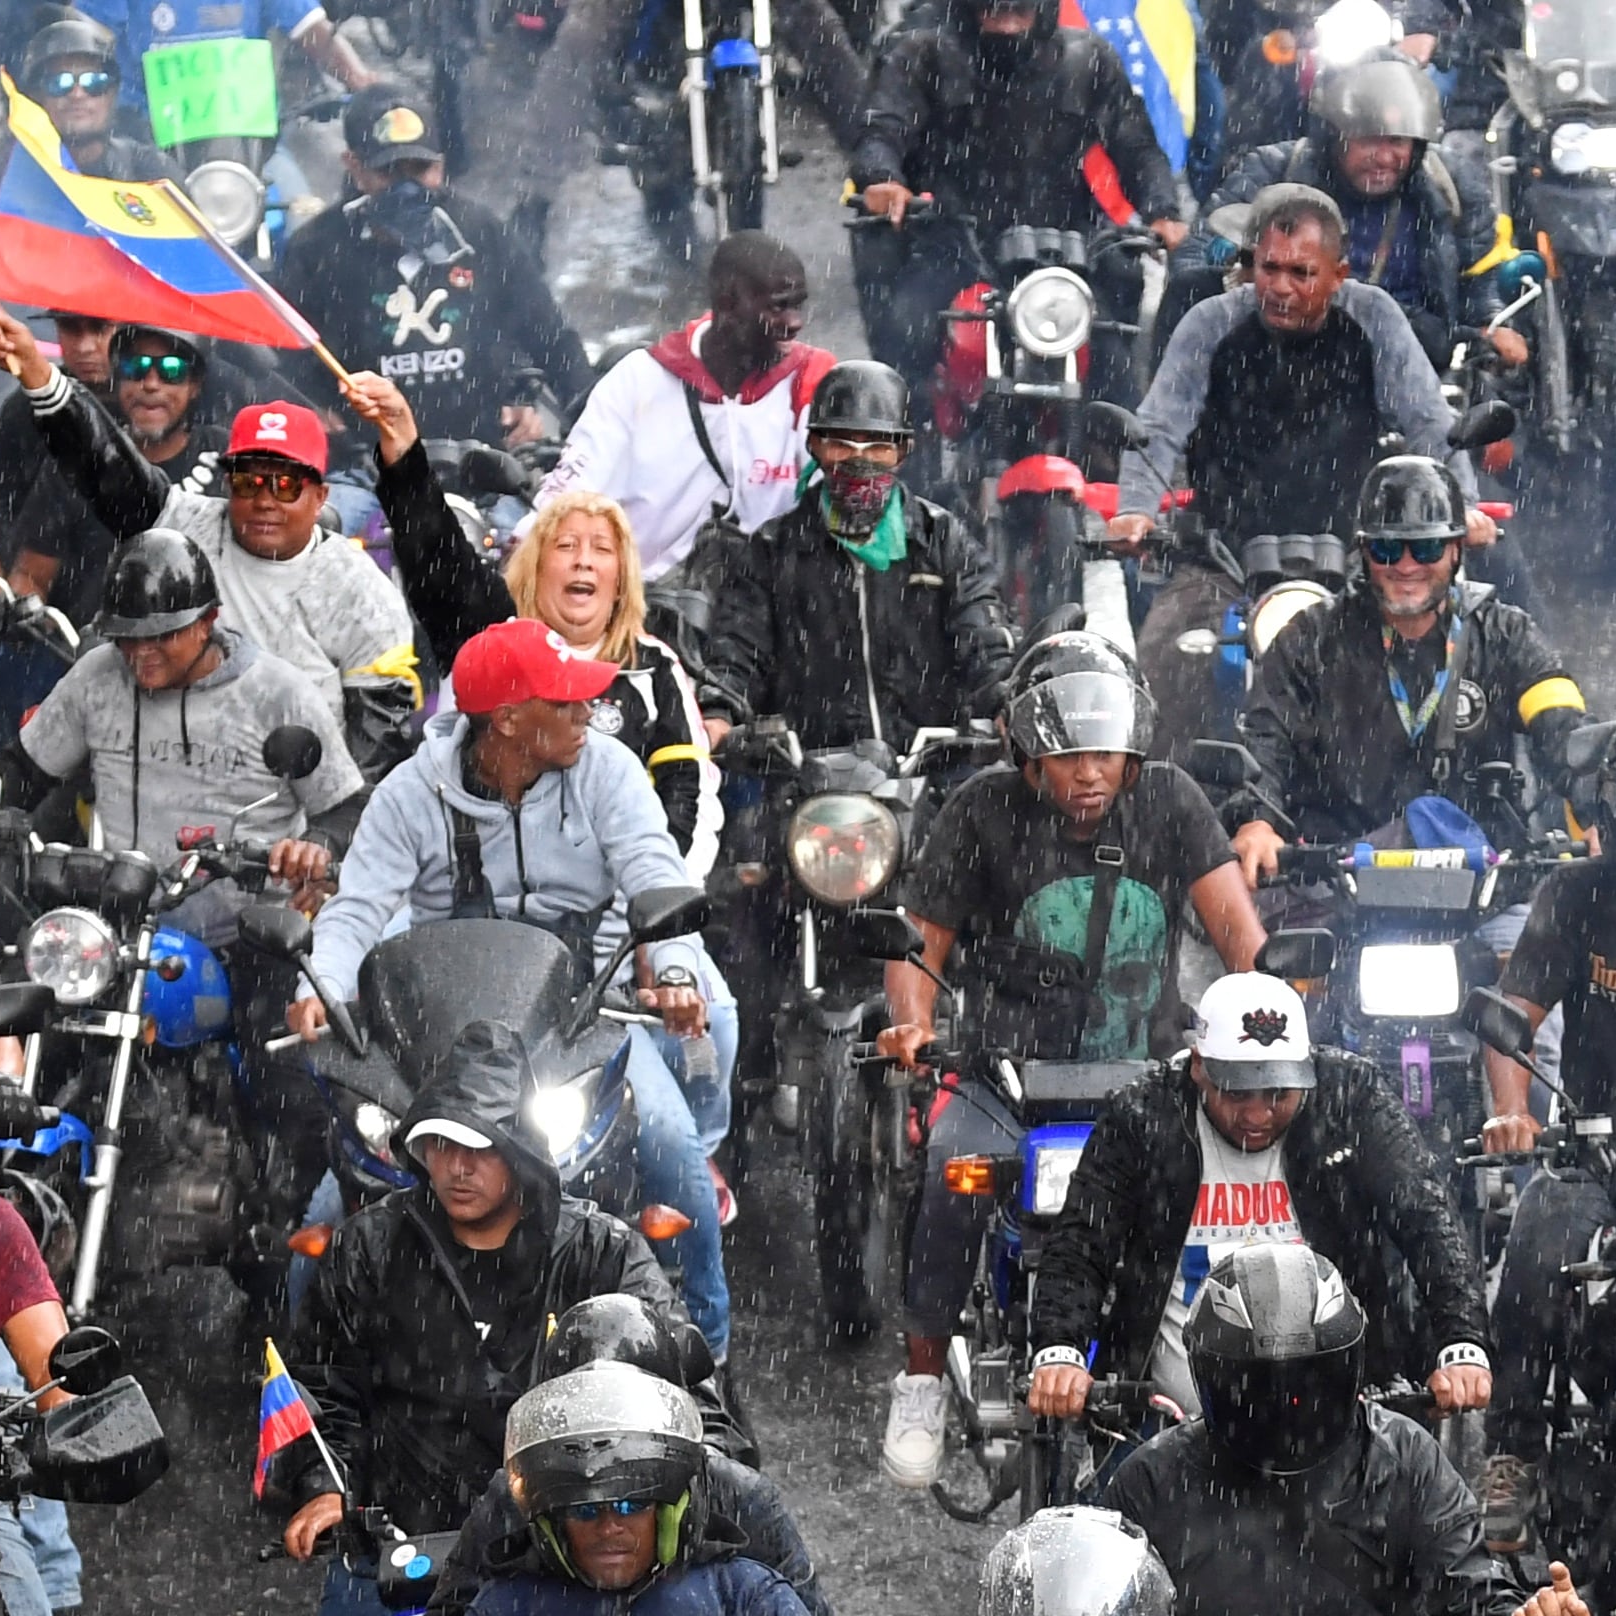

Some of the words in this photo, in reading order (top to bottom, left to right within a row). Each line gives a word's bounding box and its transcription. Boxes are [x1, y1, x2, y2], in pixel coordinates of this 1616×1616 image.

[380, 347, 466, 376] KENZO
[1192, 1180, 1292, 1228] MADUR
[1195, 1222, 1301, 1239] RESIDENT
